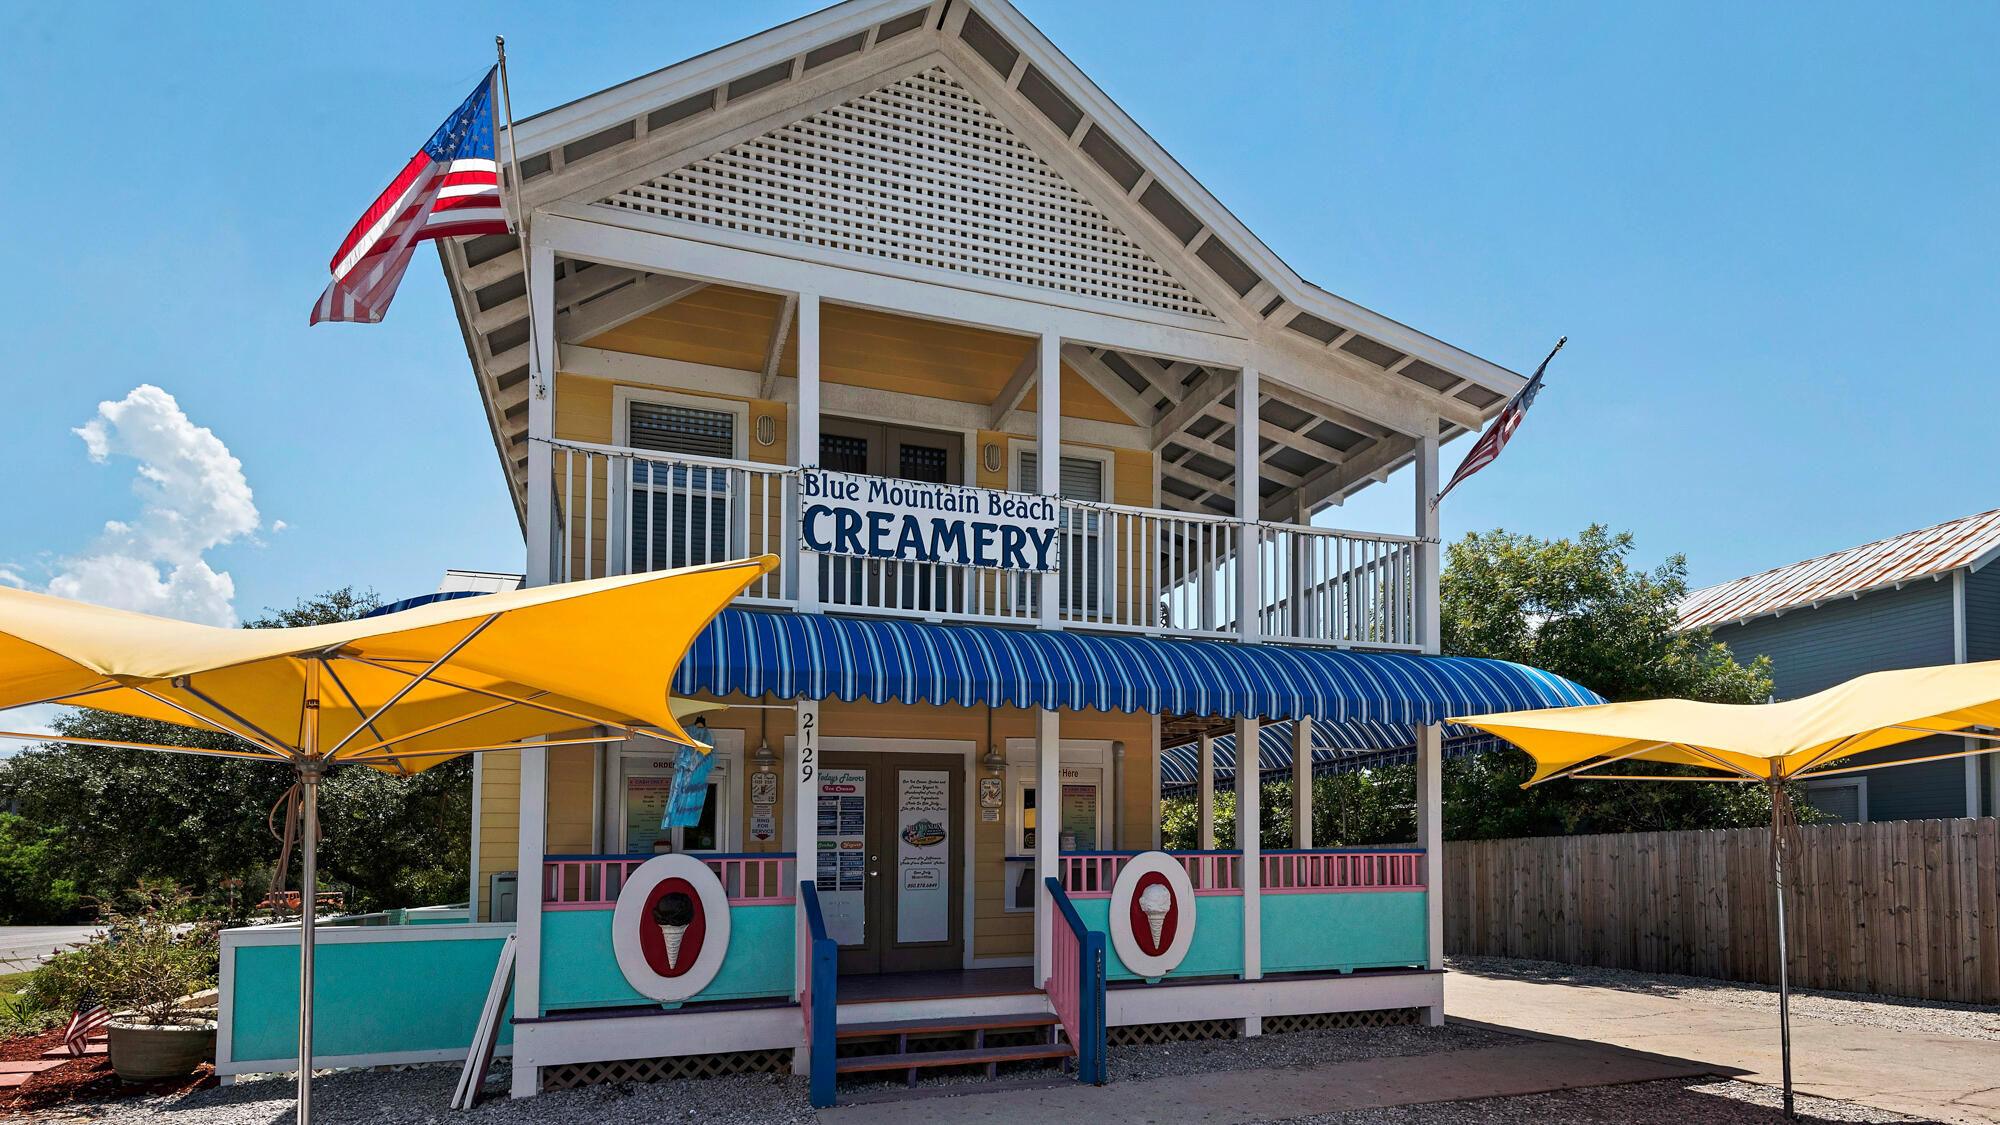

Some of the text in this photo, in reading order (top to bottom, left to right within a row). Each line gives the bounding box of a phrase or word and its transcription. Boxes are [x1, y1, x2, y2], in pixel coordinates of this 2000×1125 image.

[805, 473, 1054, 521] Blue Mountain Beach
[803, 504, 1056, 570] CREAMERY
[802, 713, 813, 783] 2129
[1062, 769, 1079, 778] Here
